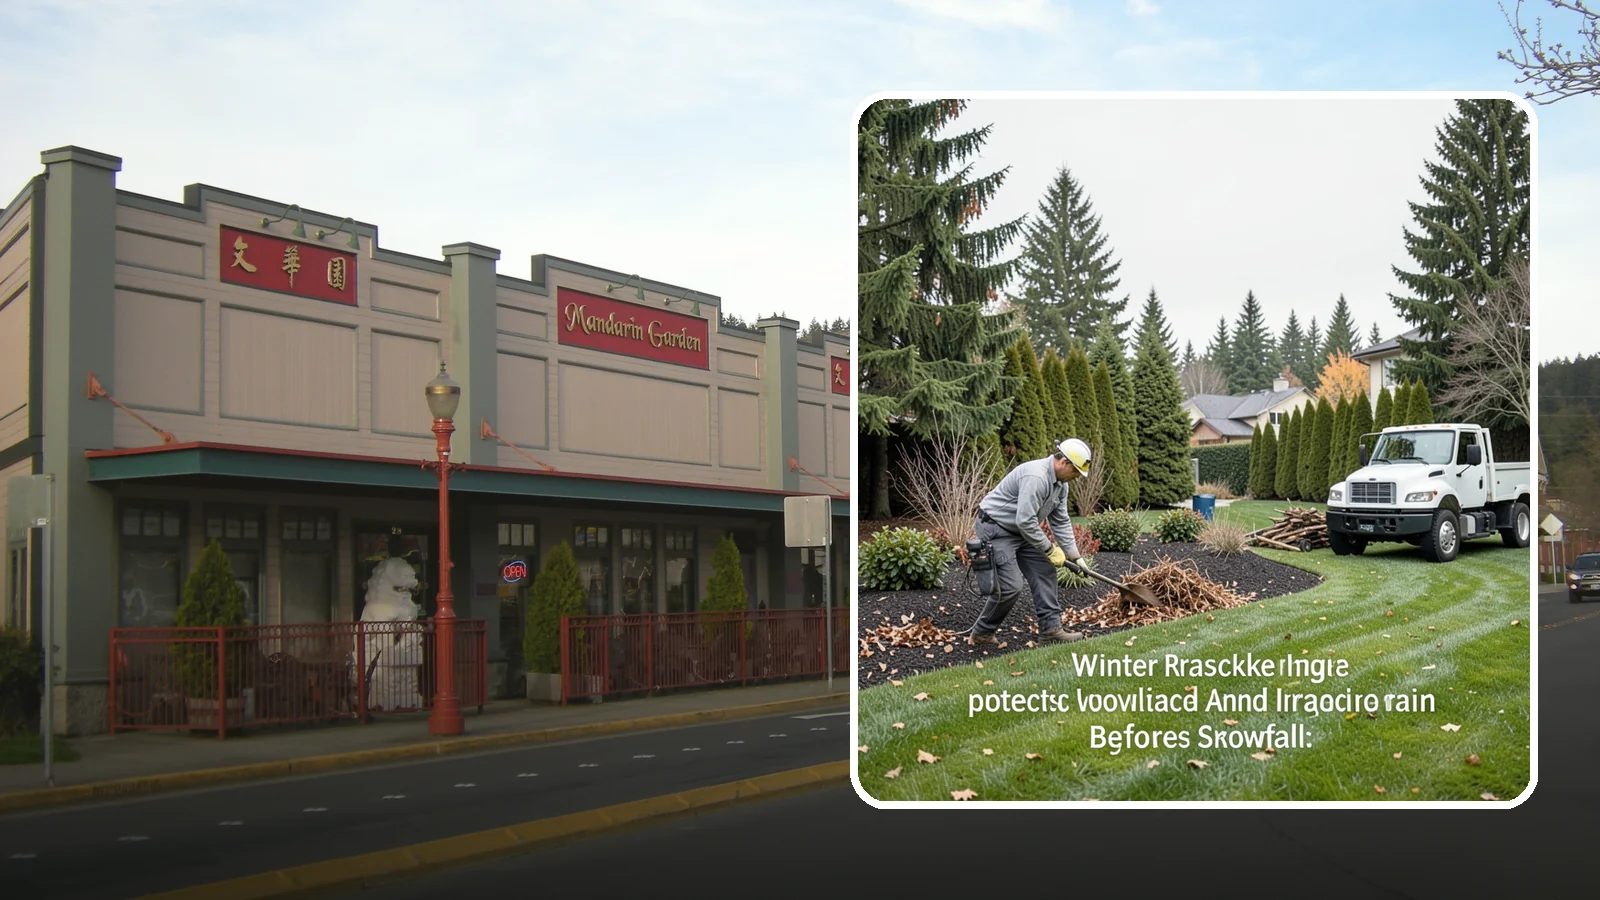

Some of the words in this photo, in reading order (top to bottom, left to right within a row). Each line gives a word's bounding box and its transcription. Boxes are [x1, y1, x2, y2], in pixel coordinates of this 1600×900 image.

[231, 235, 346, 291] 文華園
[564, 302, 644, 341] Mandarin
[648, 320, 701, 352] Garden
[503, 565, 526, 578] OPEN
